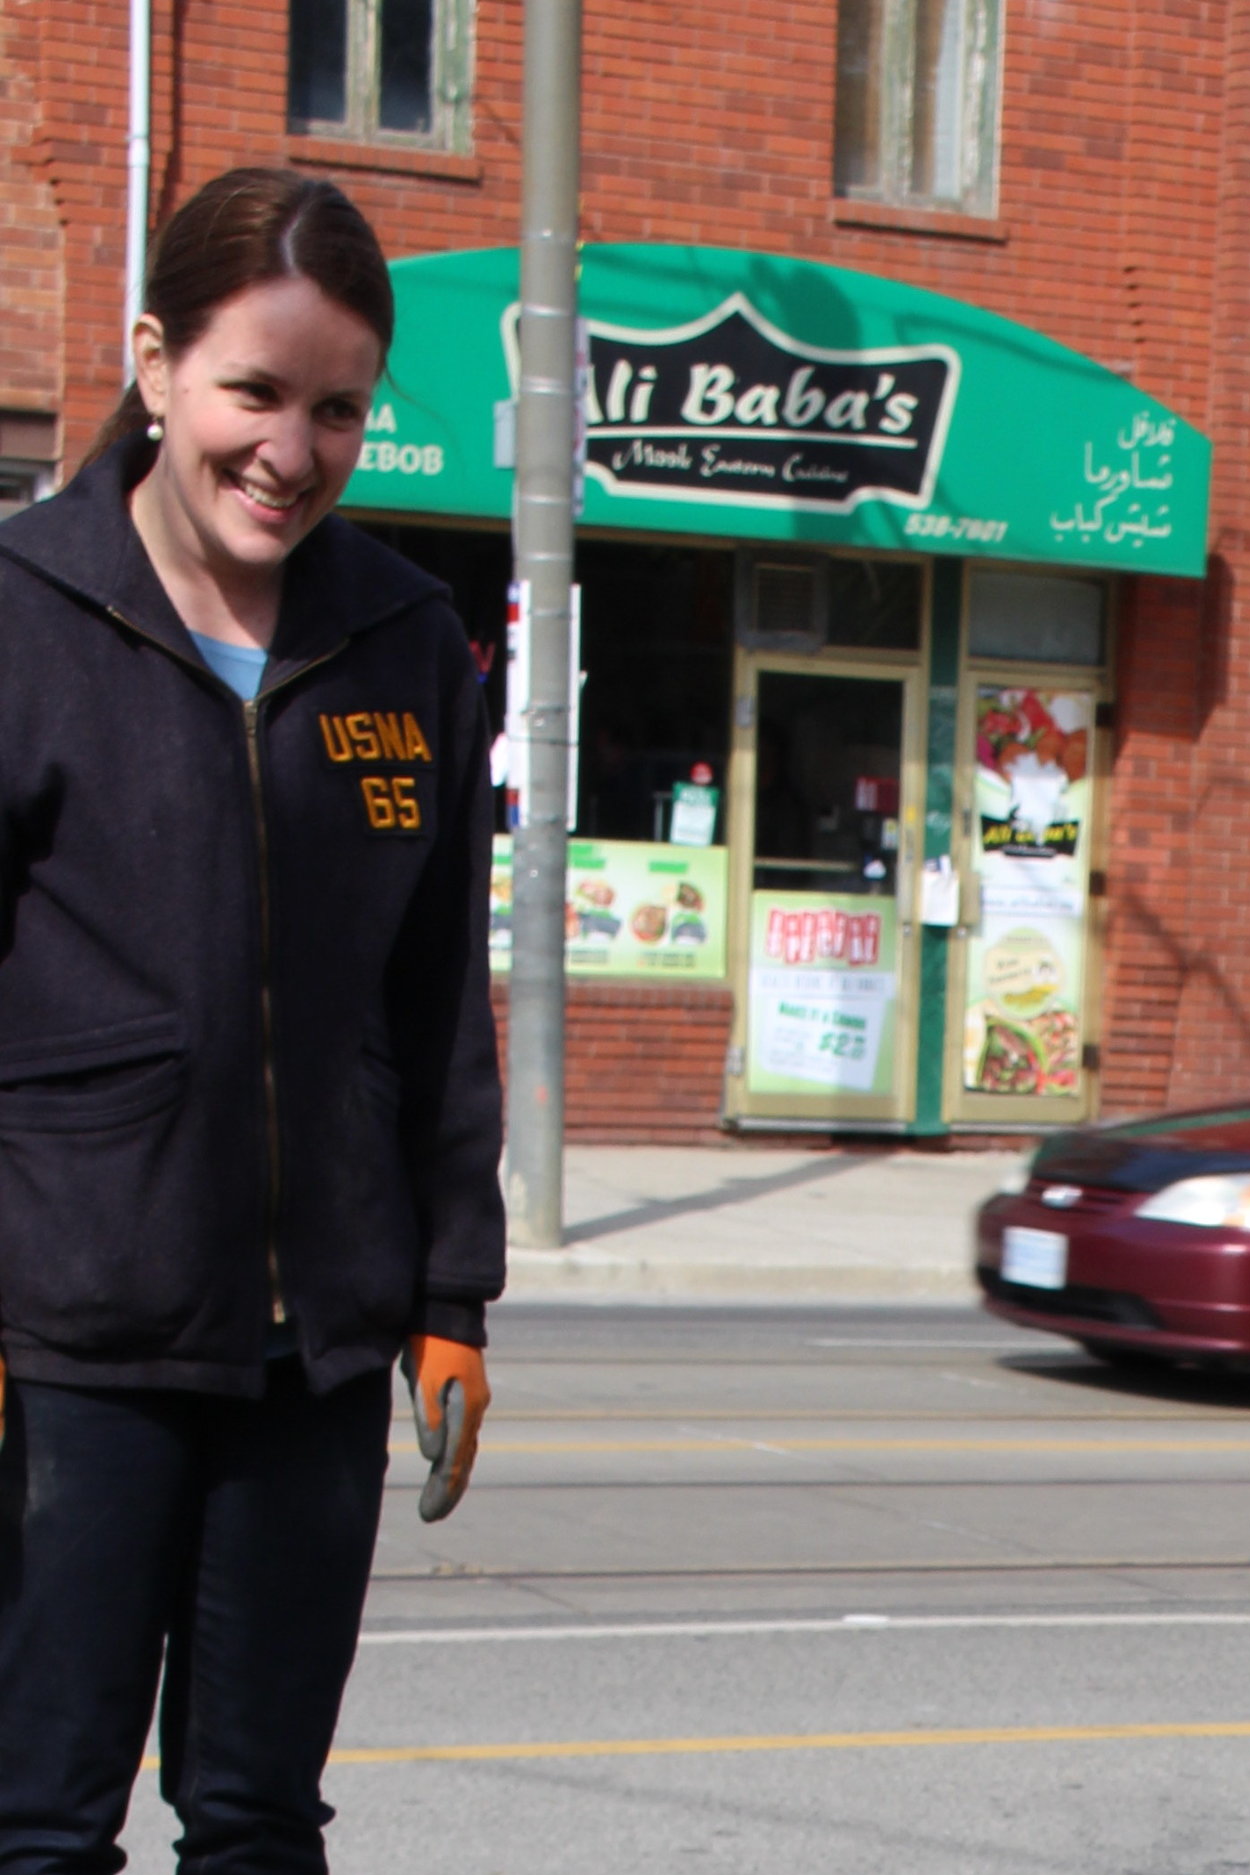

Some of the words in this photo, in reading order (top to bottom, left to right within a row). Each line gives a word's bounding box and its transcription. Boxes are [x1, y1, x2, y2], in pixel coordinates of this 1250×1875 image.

[681, 362, 918, 434] Baba's
[319, 711, 432, 762] USNA
[361, 776, 421, 829] 65
